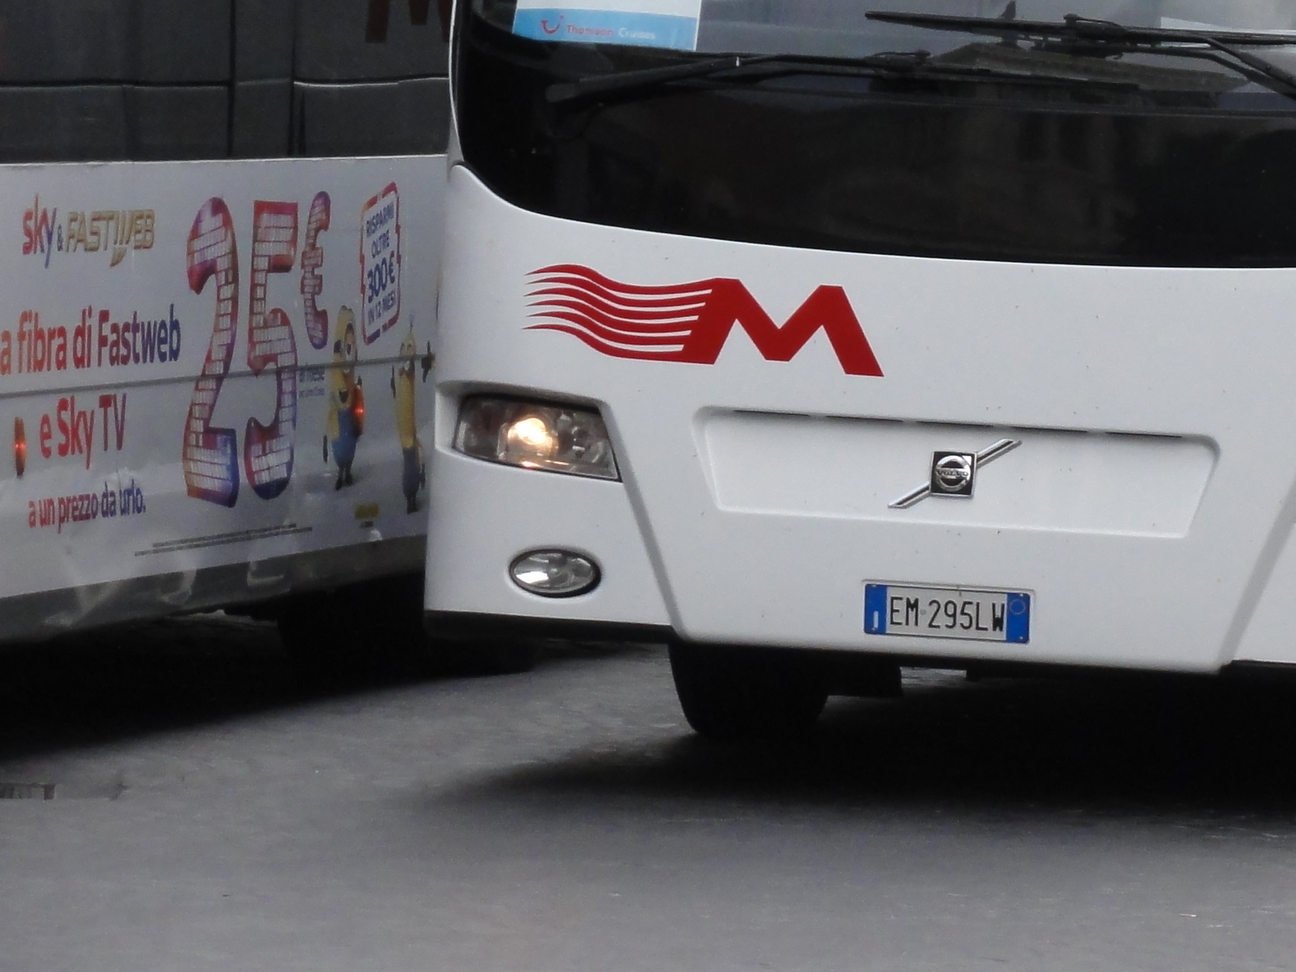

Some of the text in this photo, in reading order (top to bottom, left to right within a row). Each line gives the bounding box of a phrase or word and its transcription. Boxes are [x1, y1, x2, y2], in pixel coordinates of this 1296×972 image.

[565, 24, 656, 40] Thomson Cruises
[22, 193, 58, 270] sky
[65, 209, 156, 268] FASTWEB
[370, 229, 390, 259] OLTRE
[367, 250, 396, 304] 300€
[17, 309, 68, 374] fibra
[73, 304, 93, 370] di
[97, 303, 182, 368] Fastweb
[39, 393, 127, 470] e Sky TV
[28, 500, 36, 529] a
[38, 497, 56, 528] un
[58, 492, 98, 534] prezzo
[101, 481, 117, 519] da
